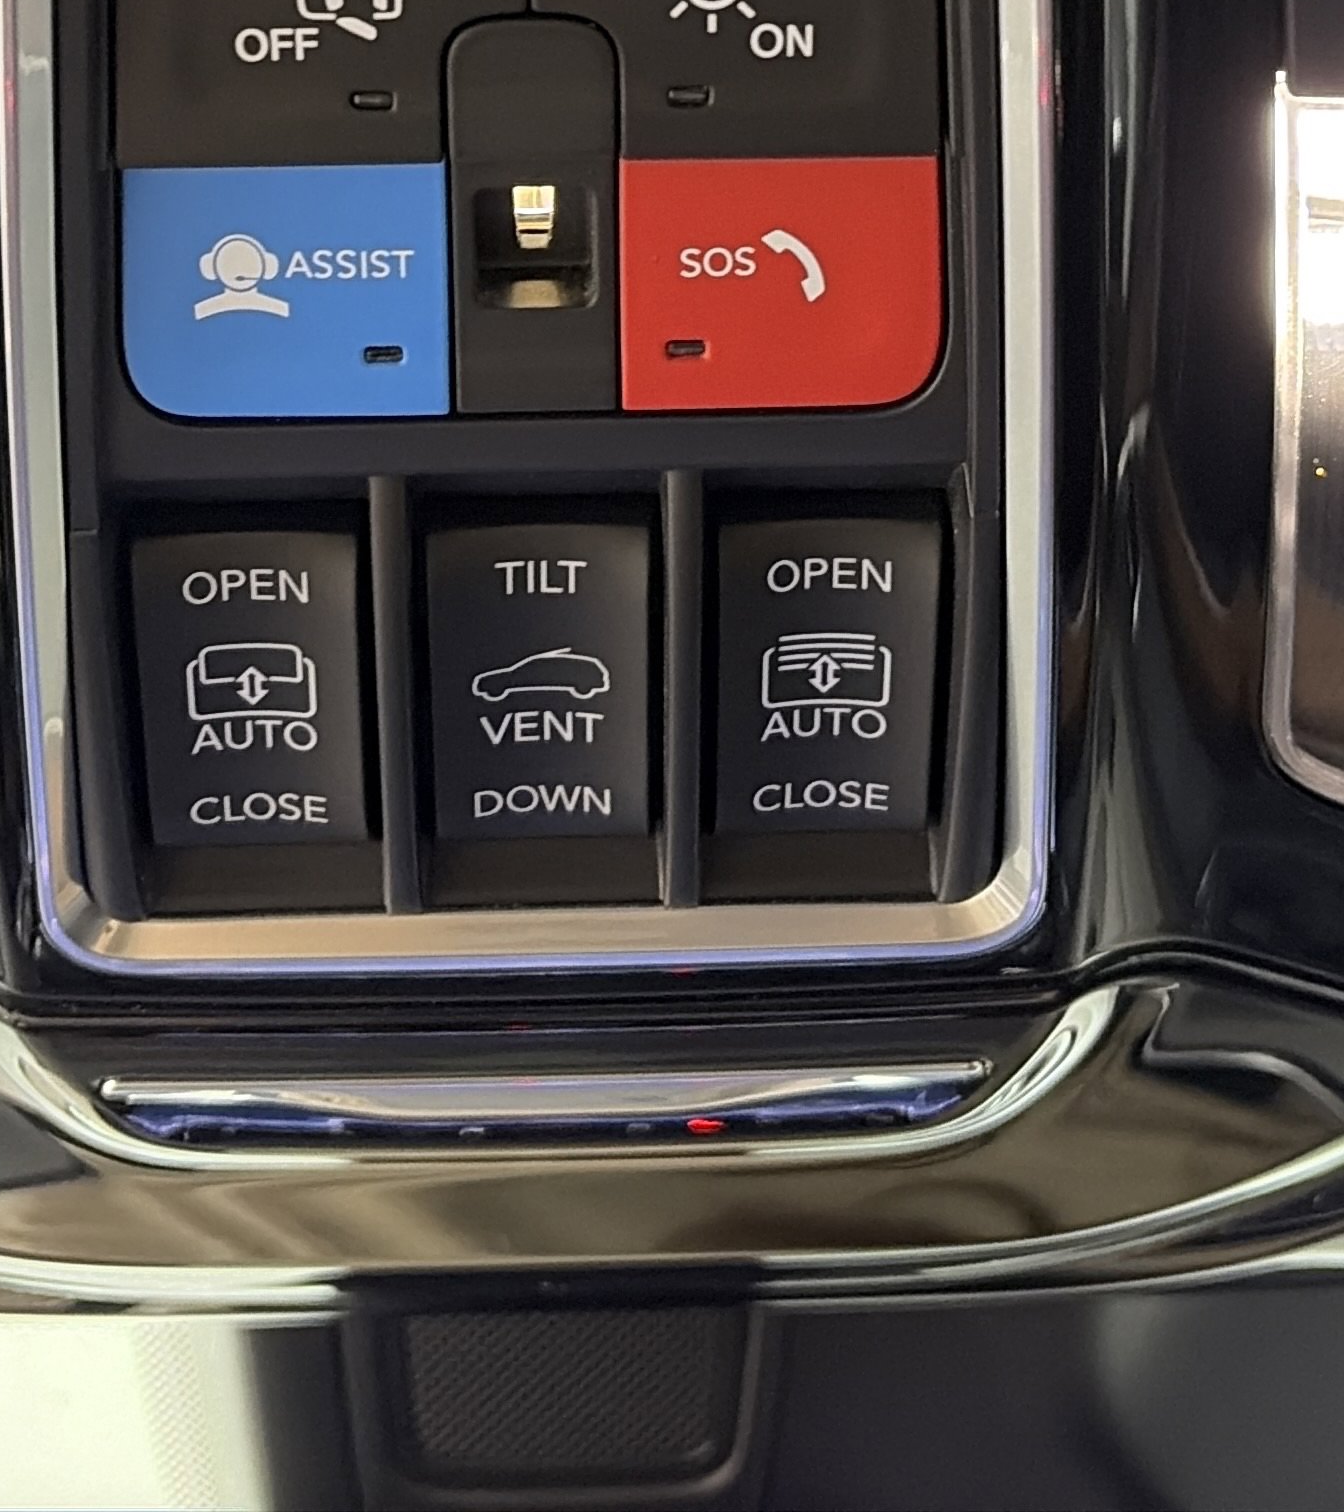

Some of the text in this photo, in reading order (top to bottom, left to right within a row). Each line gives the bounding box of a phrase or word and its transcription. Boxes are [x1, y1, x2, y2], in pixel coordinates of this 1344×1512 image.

[234, 27, 320, 63] OFF
[749, 22, 814, 59] ON
[284, 249, 415, 279] ASSIST
[679, 246, 757, 278] SOS
[182, 568, 310, 605] OPEN
[494, 559, 588, 595] TILT
[767, 557, 893, 593] OPEN
[190, 720, 318, 754] AUTO
[479, 710, 605, 745] VENT
[759, 708, 888, 741] AUTO
[190, 792, 329, 825] CLOSE
[474, 784, 612, 818] DOWN
[752, 779, 890, 812] CLOSE
